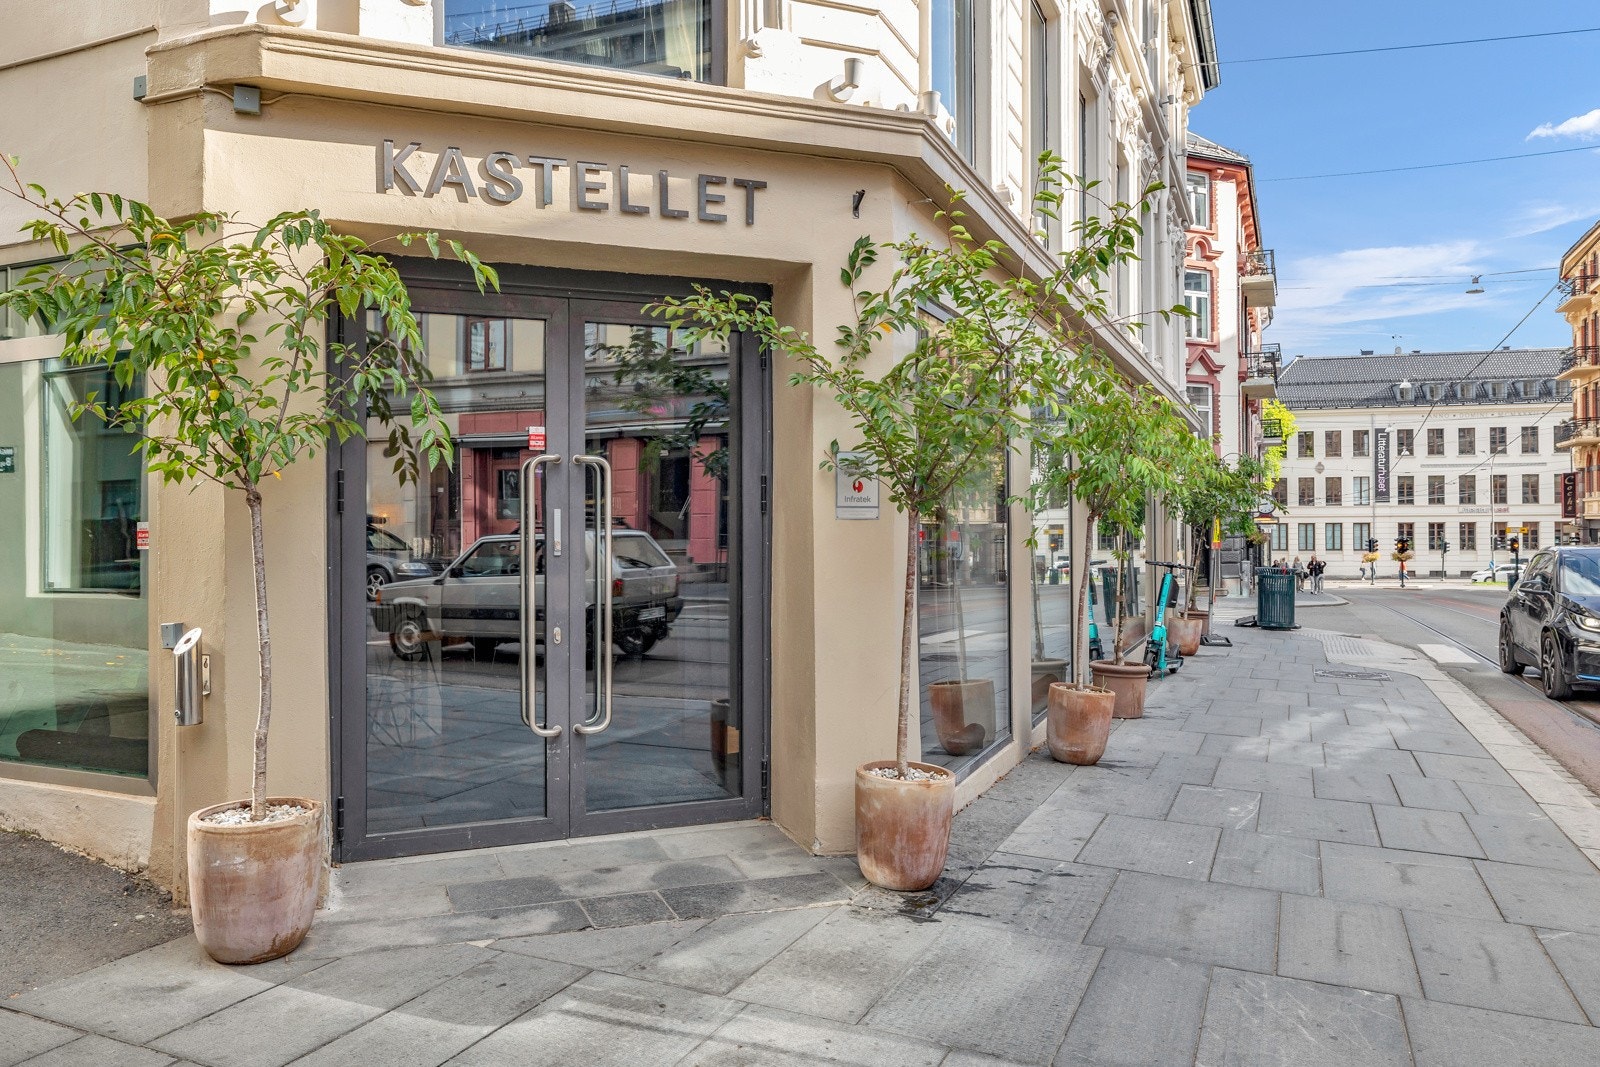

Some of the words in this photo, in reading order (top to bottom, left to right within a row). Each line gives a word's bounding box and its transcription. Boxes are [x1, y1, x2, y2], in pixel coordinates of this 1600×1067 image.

[382, 138, 768, 226] KASTELLET
[1377, 432, 1387, 492] Litteraturhuset
[844, 495, 872, 503] Infratek
[1564, 475, 1575, 511] Cochs
